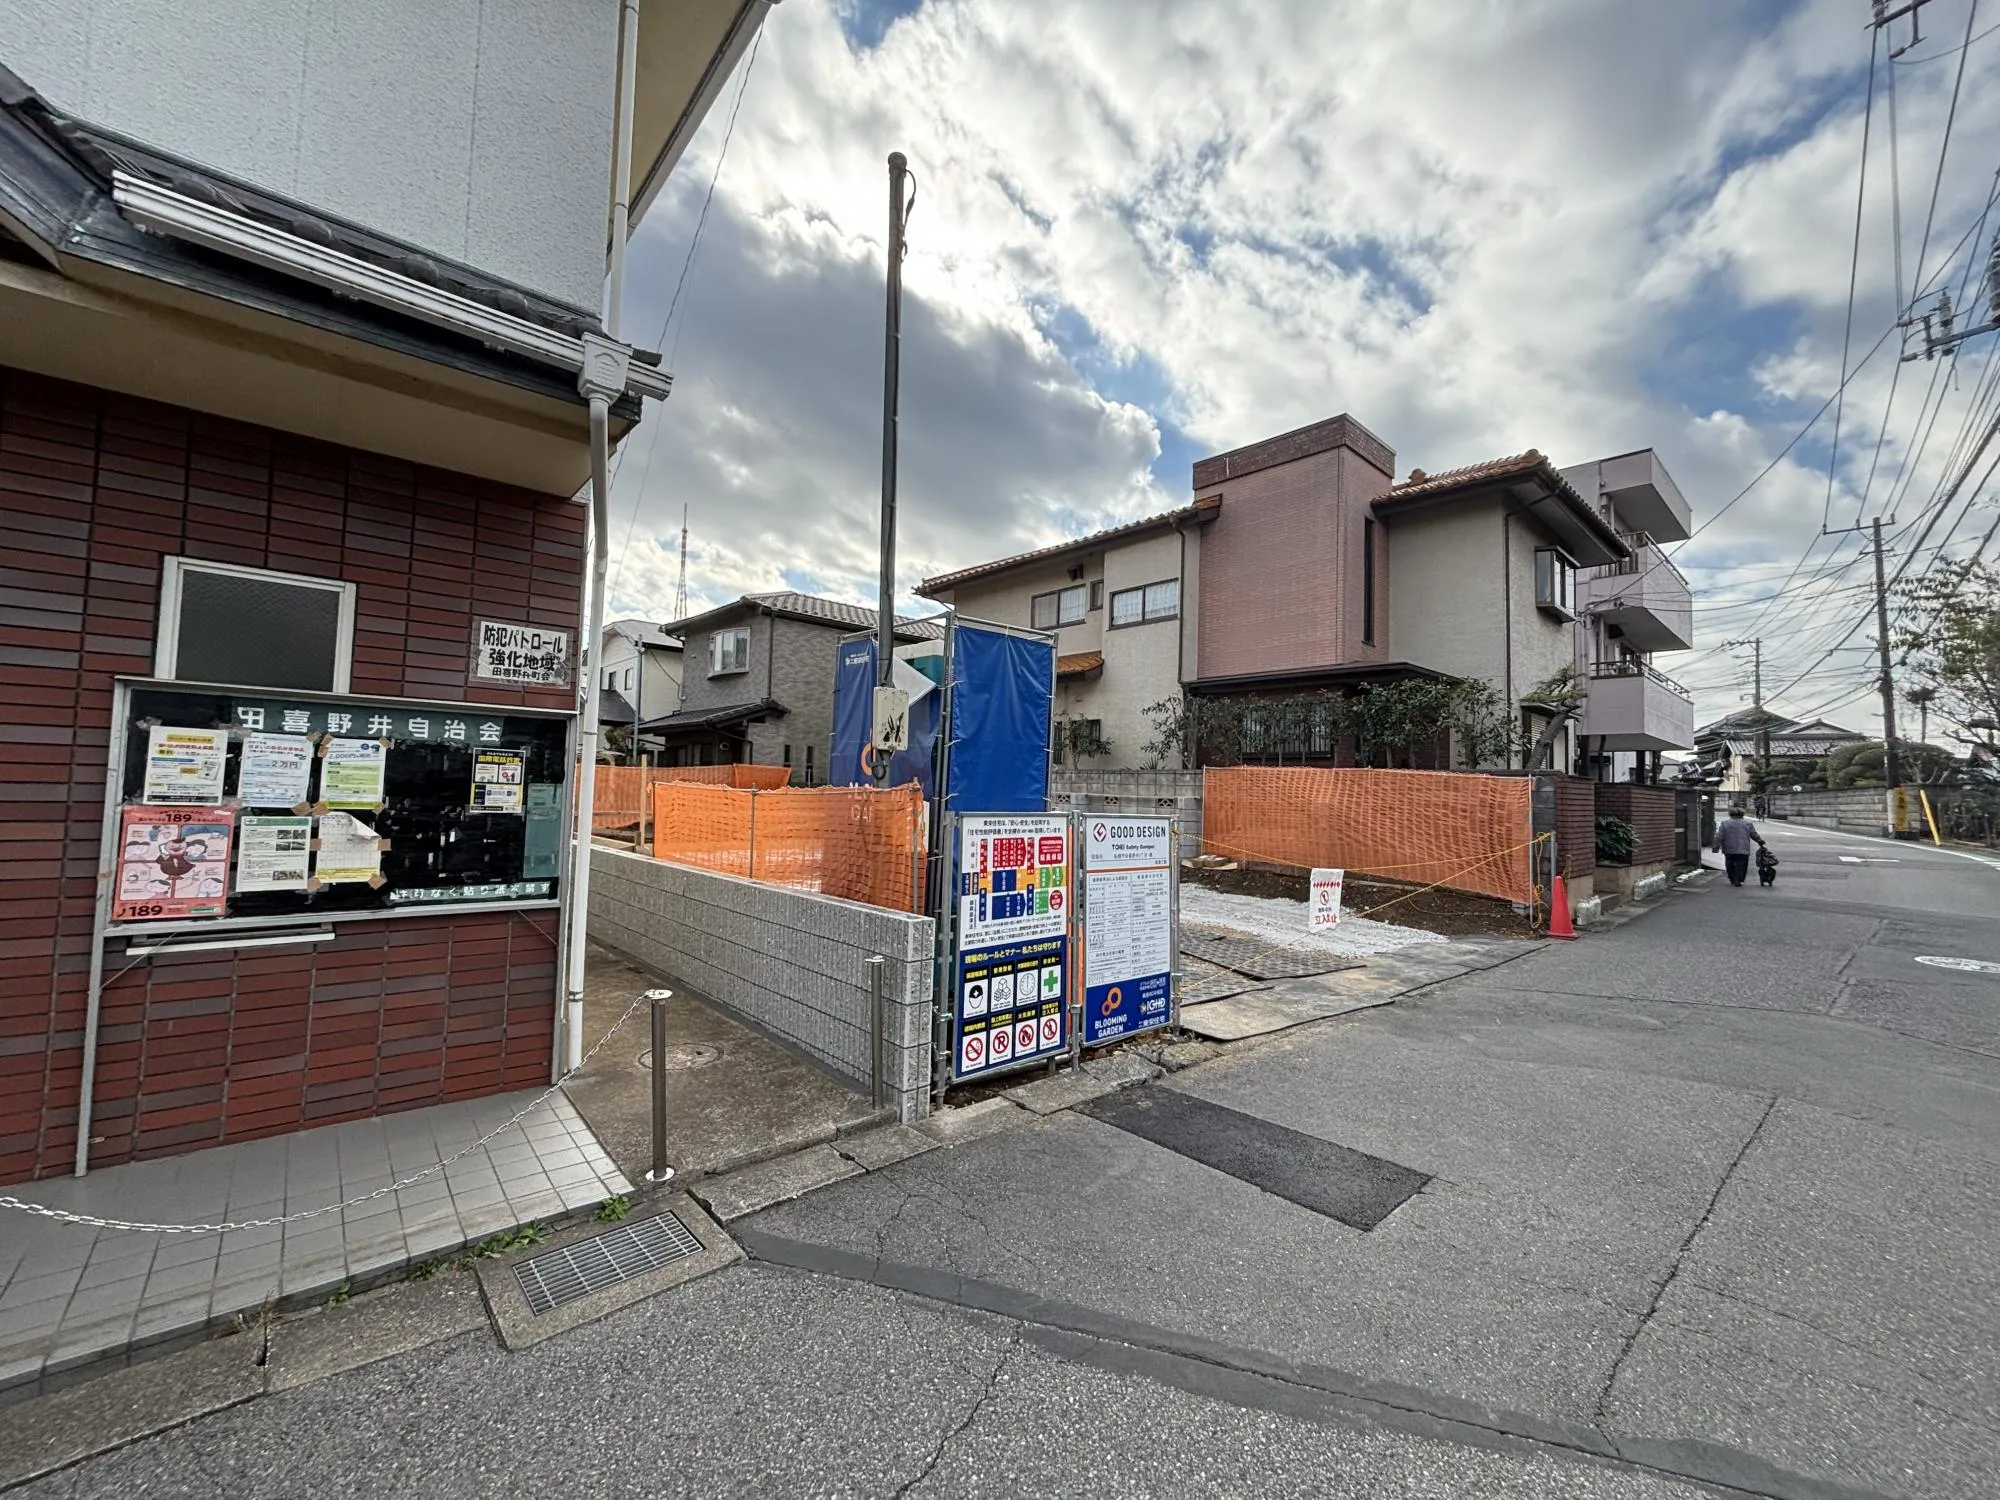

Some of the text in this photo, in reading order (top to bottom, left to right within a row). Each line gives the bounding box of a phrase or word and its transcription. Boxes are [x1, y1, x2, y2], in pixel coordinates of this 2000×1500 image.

[483, 625, 562, 653] 防犯パトロール
[488, 648, 555, 671] 強化地域
[166, 814, 192, 823] 189
[1111, 826, 1166, 839] GOOD DESIGN
[129, 905, 163, 917] 189
[1095, 1014, 1128, 1029] BLOOMING
[1098, 1025, 1124, 1038] GARDEN
